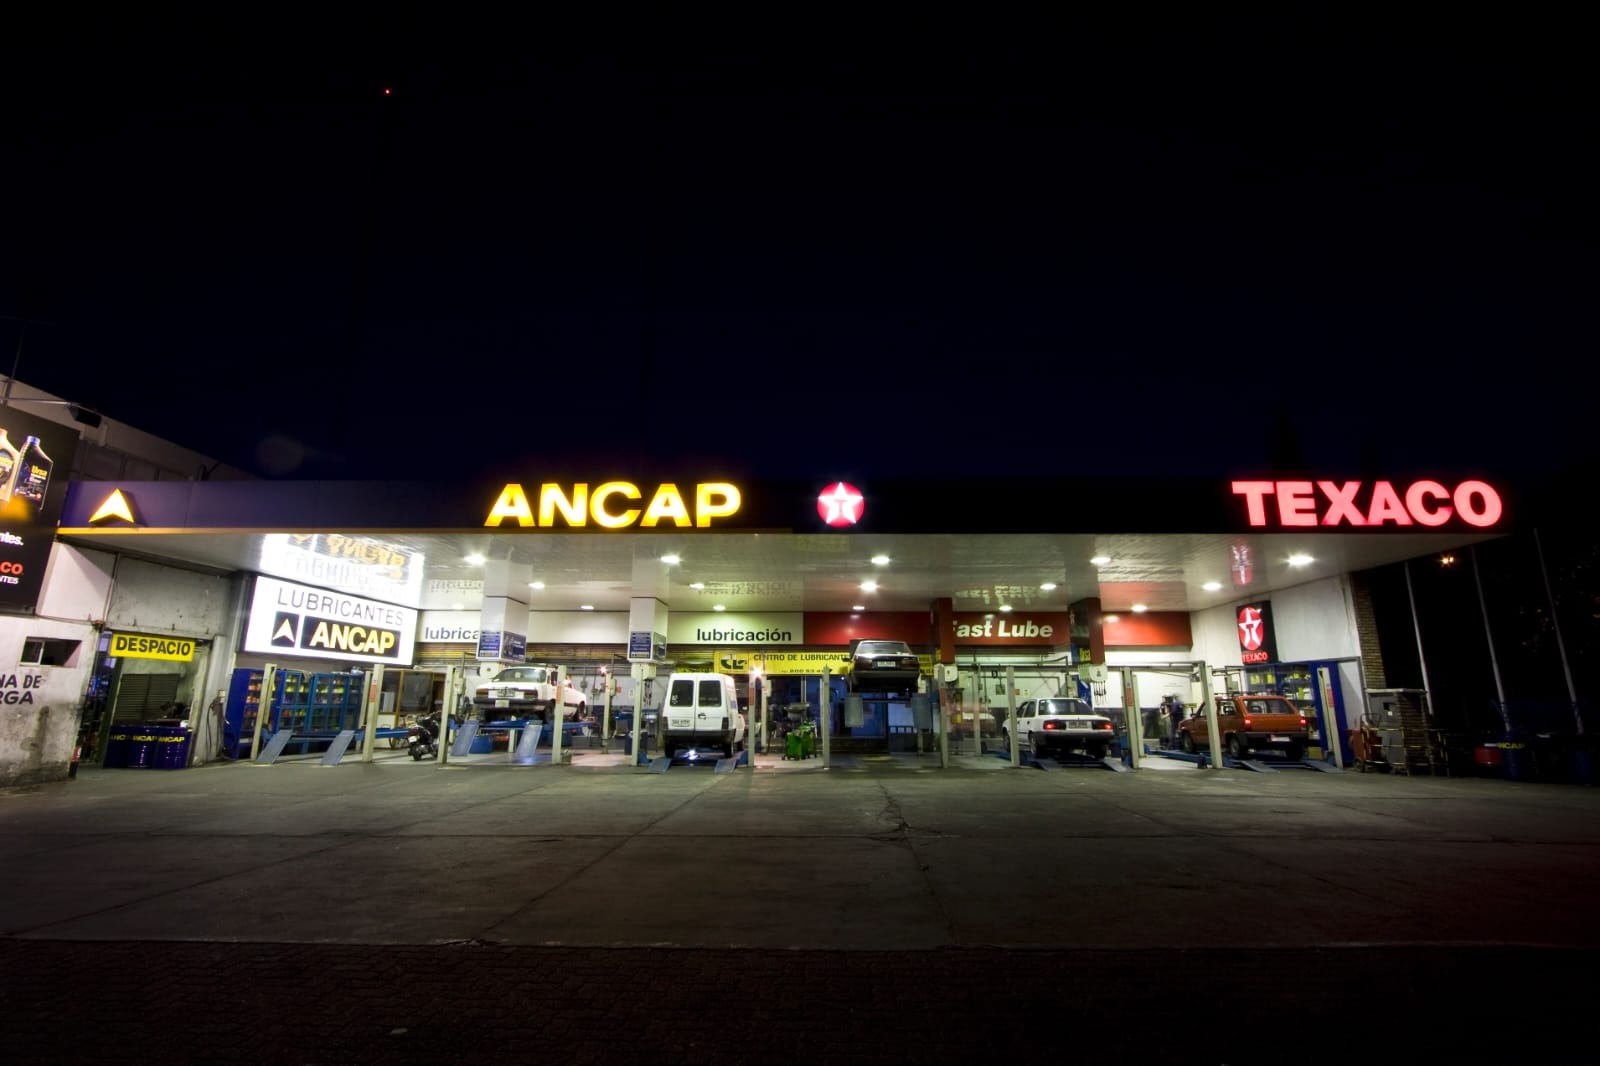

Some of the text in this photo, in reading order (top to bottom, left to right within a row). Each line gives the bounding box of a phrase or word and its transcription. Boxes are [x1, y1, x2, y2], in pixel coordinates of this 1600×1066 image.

[484, 481, 741, 528] ANCAP
[1231, 480, 1502, 527] TEXACO
[278, 587, 404, 626] LUBRICANTES
[309, 621, 396, 654] ANCAP
[697, 627, 792, 641] lubricación
[998, 620, 1053, 638] Lube
[115, 636, 191, 656] DESPACIO
[1243, 651, 1268, 663] TEXACO
[23, 674, 42, 689] DE
